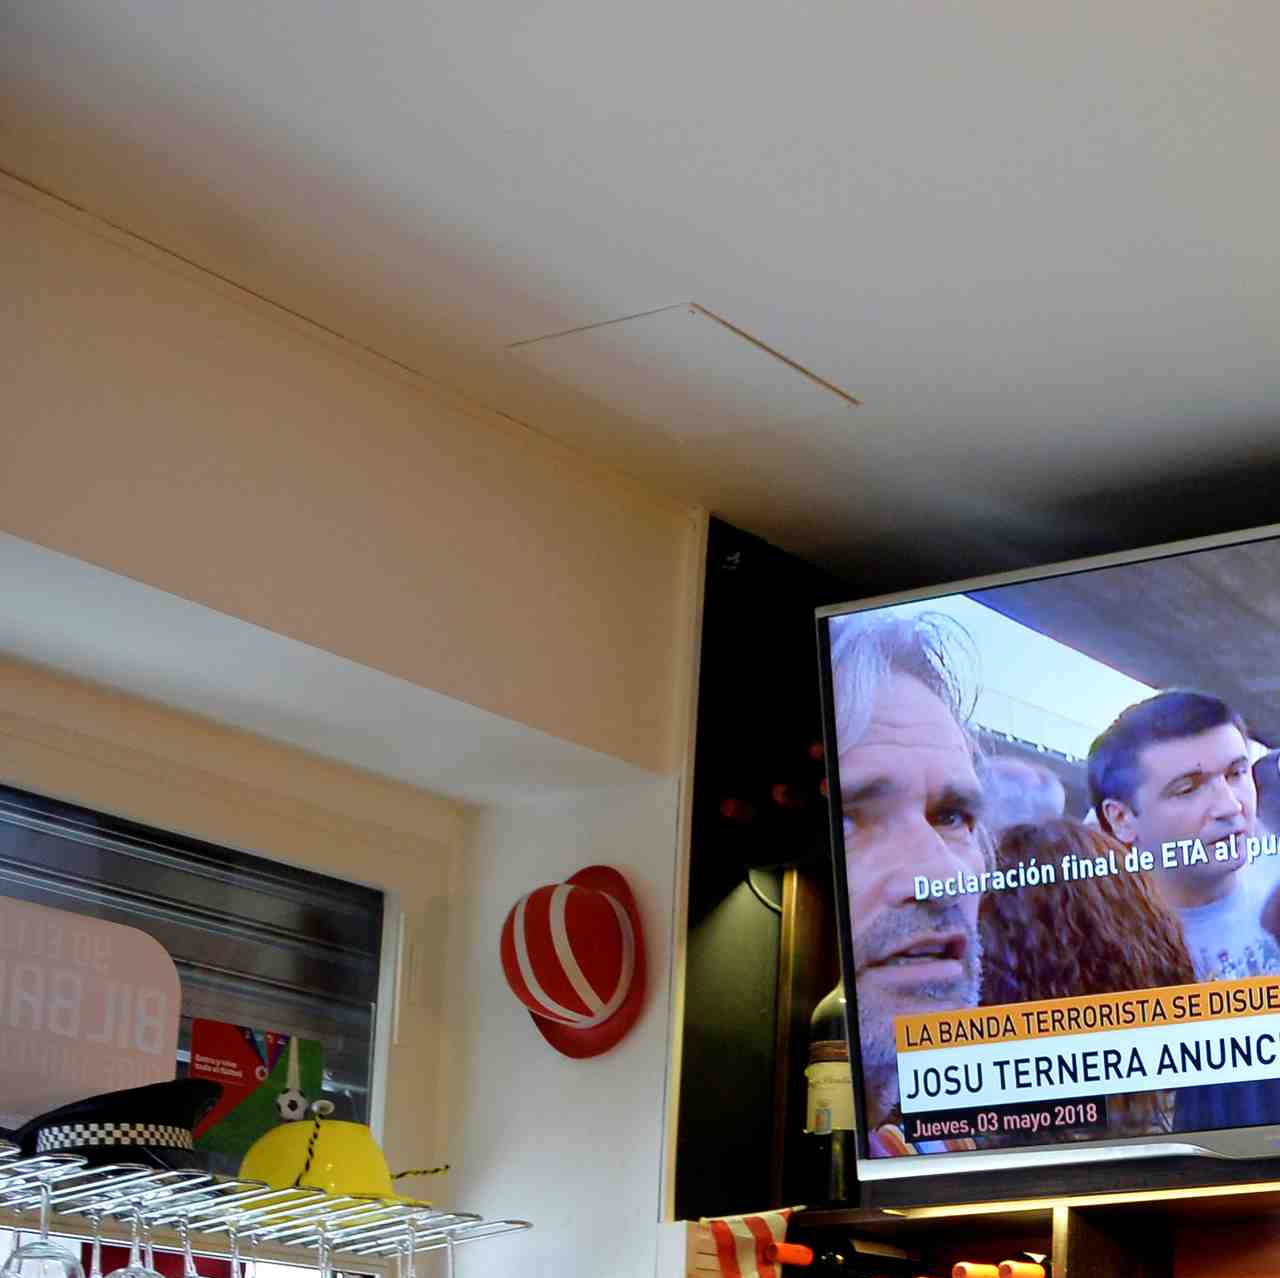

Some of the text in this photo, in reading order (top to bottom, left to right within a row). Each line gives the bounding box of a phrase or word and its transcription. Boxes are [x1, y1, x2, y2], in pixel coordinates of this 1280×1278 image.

[913, 860, 1056, 901] Declaración
[1062, 855, 1117, 882] final
[1125, 846, 1154, 872] de
[1161, 842, 1208, 867] ETA
[1214, 838, 1239, 861] al
[905, 1021, 933, 1047] LA
[940, 1014, 1017, 1043] BANDA
[1022, 998, 1167, 1034] TERRORISTA
[1173, 993, 1202, 1018] SE
[906, 1062, 984, 1100] JOSU
[992, 1048, 1147, 1091] TERNERA
[913, 1103, 1098, 1138] Jueves, 03 mayo 2018
